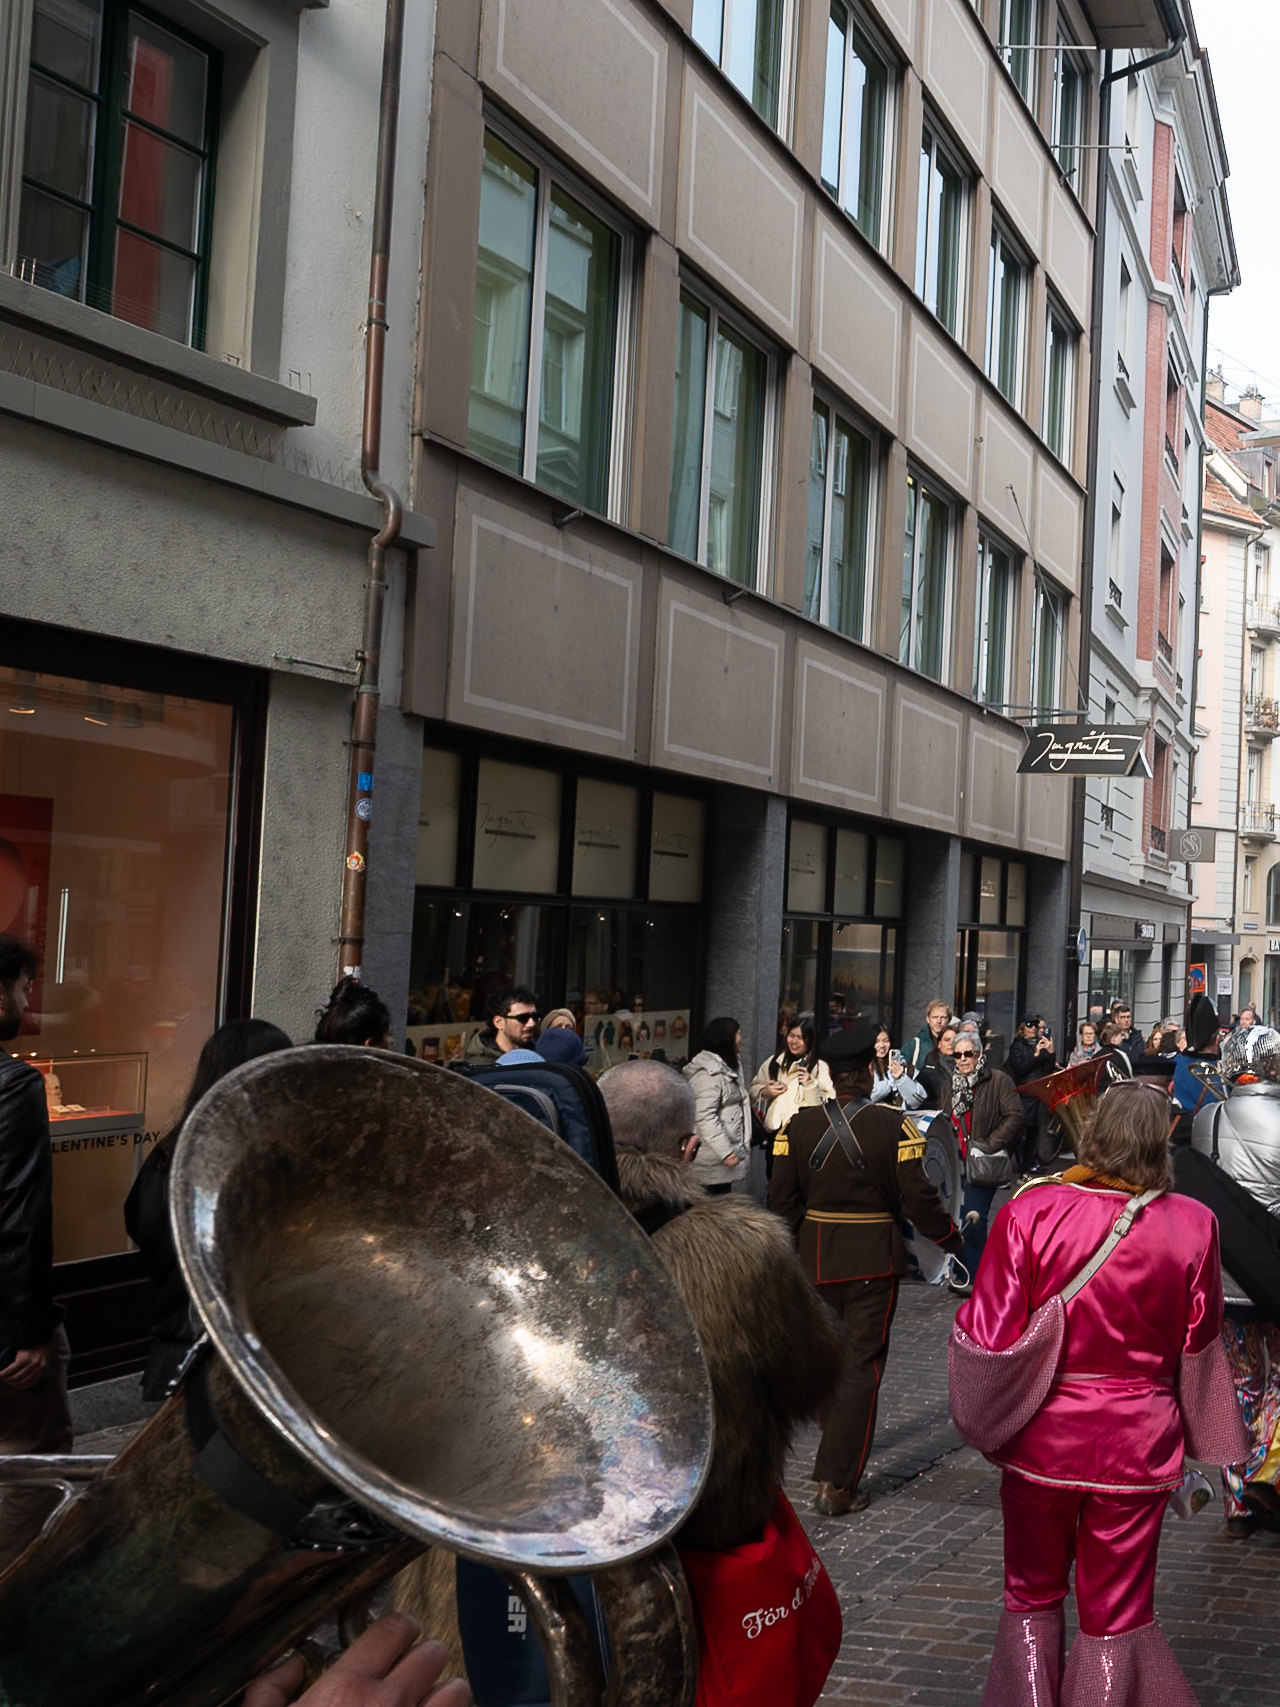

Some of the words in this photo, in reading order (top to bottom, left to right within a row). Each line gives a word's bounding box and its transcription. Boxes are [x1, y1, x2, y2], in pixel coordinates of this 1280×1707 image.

[51, 1134, 128, 1154] LENTINE'S
[133, 1131, 161, 1145] DAY
[741, 1606, 789, 1640] För
